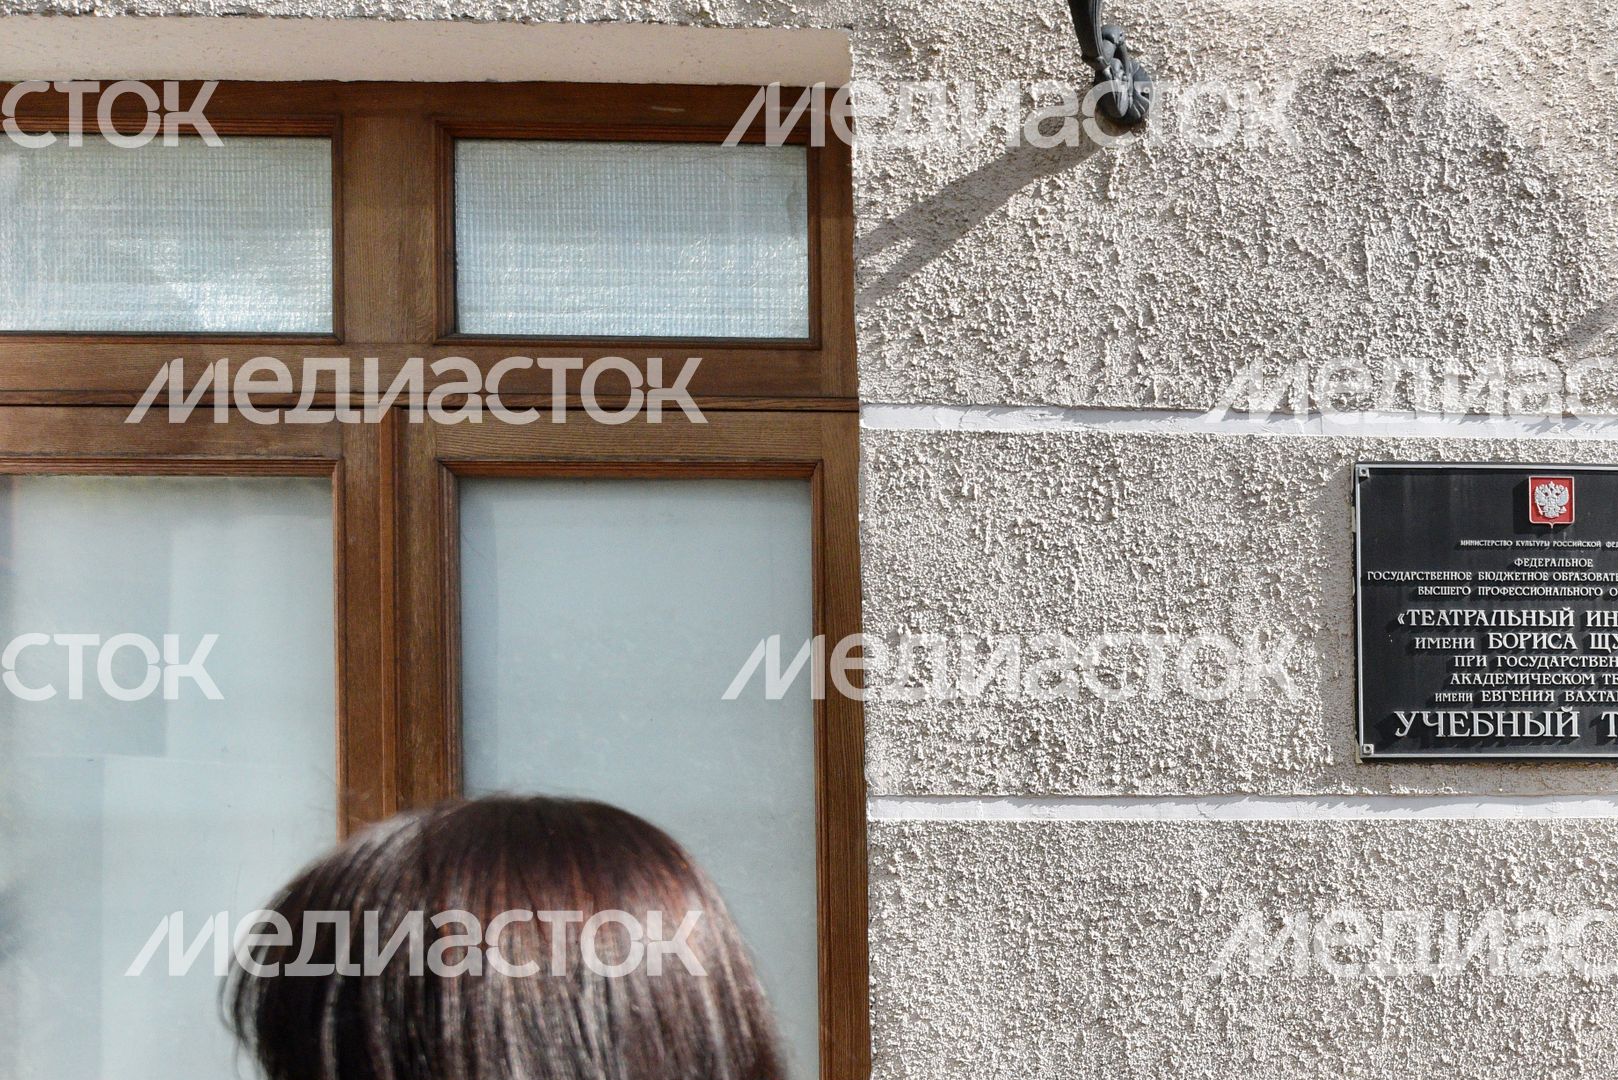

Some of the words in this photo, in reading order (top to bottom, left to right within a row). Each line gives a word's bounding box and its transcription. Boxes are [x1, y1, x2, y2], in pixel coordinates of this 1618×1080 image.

[1514, 558, 1593, 567] ФЕДЕРАЛЬНОЕ
[1368, 571, 1472, 581] ГОСУДАРСТВЕННОЕ
[1478, 572, 1549, 581] БЮДЖЕТНОЕ
[1418, 586, 1471, 595] ВЫСШЕГО
[1478, 586, 1603, 596] ПРОФЕССИОНАЛЬНОГО
[1398, 607, 1575, 626] «ТЕАТРАЛЬНЫЙ
[1415, 637, 1475, 649] ИМЕНИ
[1488, 632, 1578, 649] БОРИСА
[1454, 655, 1487, 666] ПРИ
[1451, 673, 1595, 686] АКАДЕМИЧЕСКОМ
[1435, 693, 1472, 701] ИМЕНИ
[1482, 690, 1555, 702] ЕВГЕНИЯ
[1394, 706, 1580, 737] УЧЕБНЫЙ
